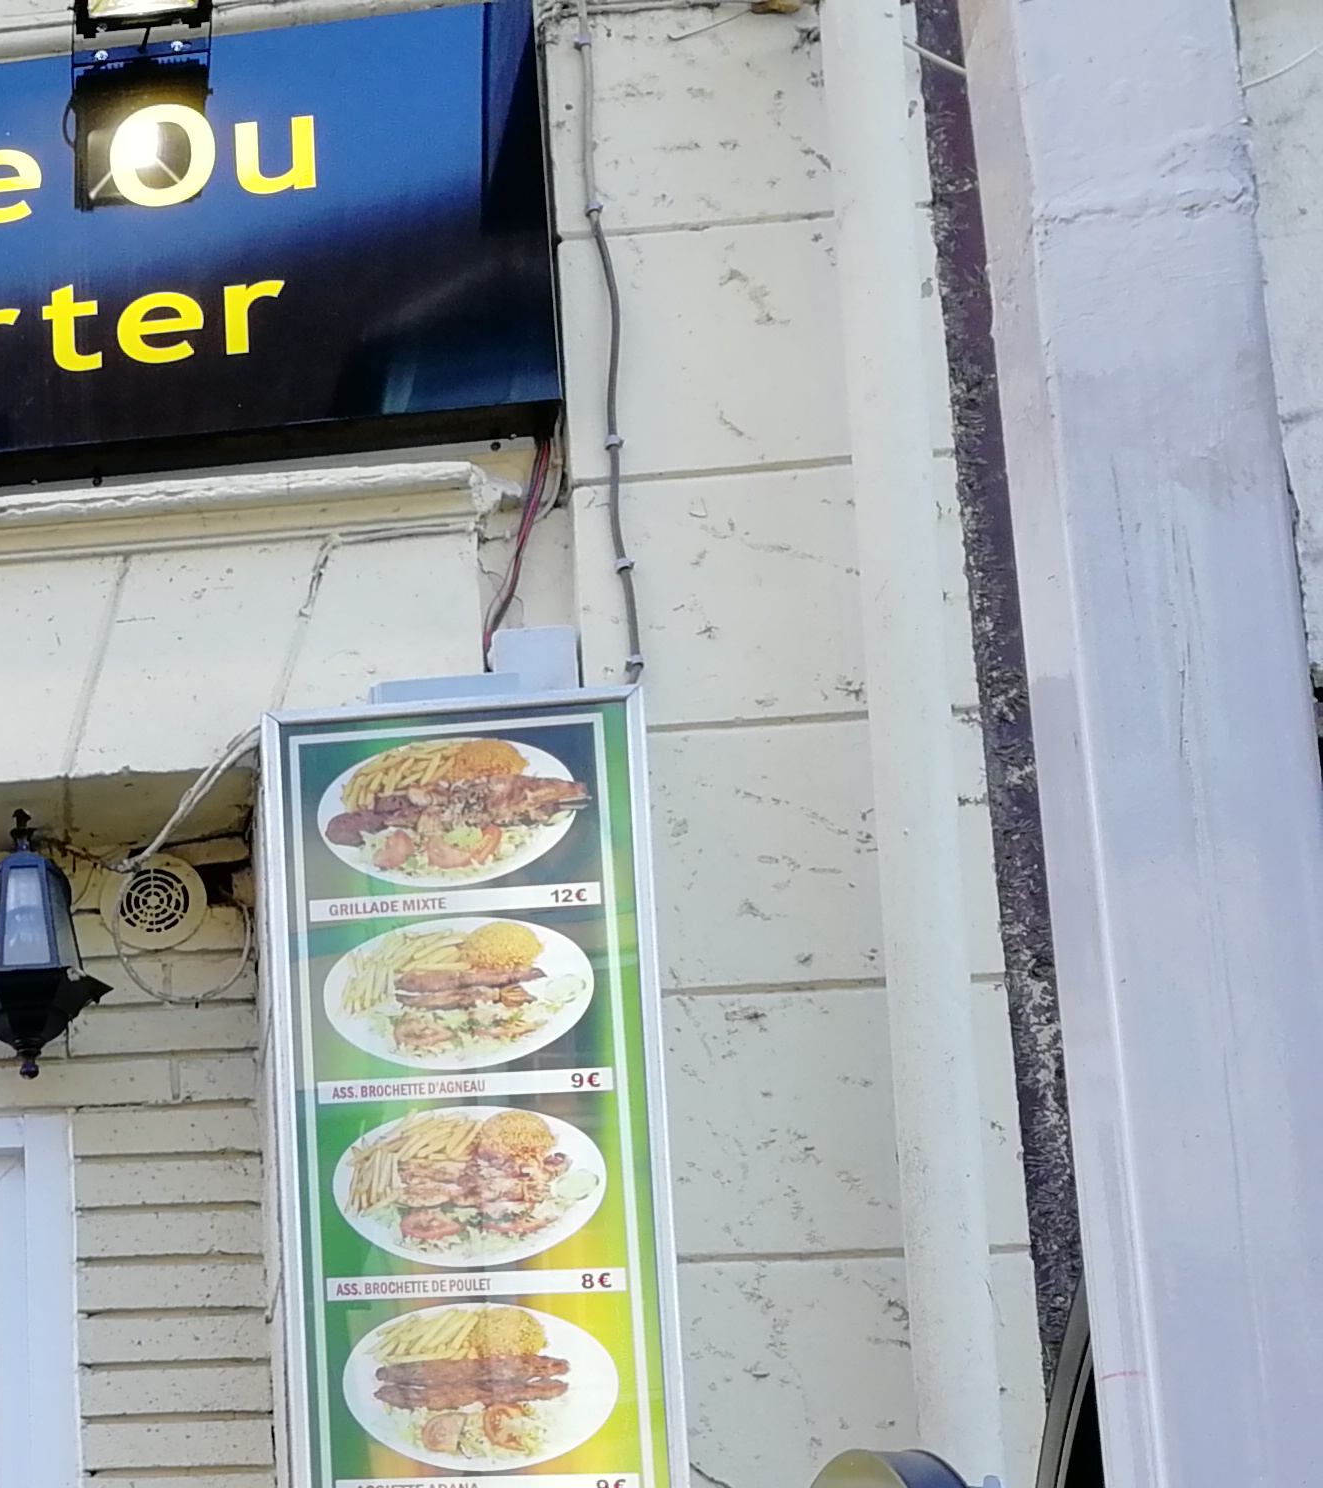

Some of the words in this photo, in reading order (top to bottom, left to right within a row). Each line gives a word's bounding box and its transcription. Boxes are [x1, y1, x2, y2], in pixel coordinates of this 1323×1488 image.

[108, 103, 318, 207] Ou
[328, 900, 399, 916] GRILLADE
[402, 897, 447, 912] MIXTE
[550, 888, 587, 903] 12€
[332, 1085, 358, 1099] ASS.
[360, 1082, 425, 1098] BROCHETTE
[428, 1079, 486, 1096] D'AGNEAU
[336, 1282, 362, 1296] ASS.
[364, 1280, 429, 1295] BROCHETTE
[431, 1279, 447, 1293] DE
[449, 1278, 492, 1292] POULET
